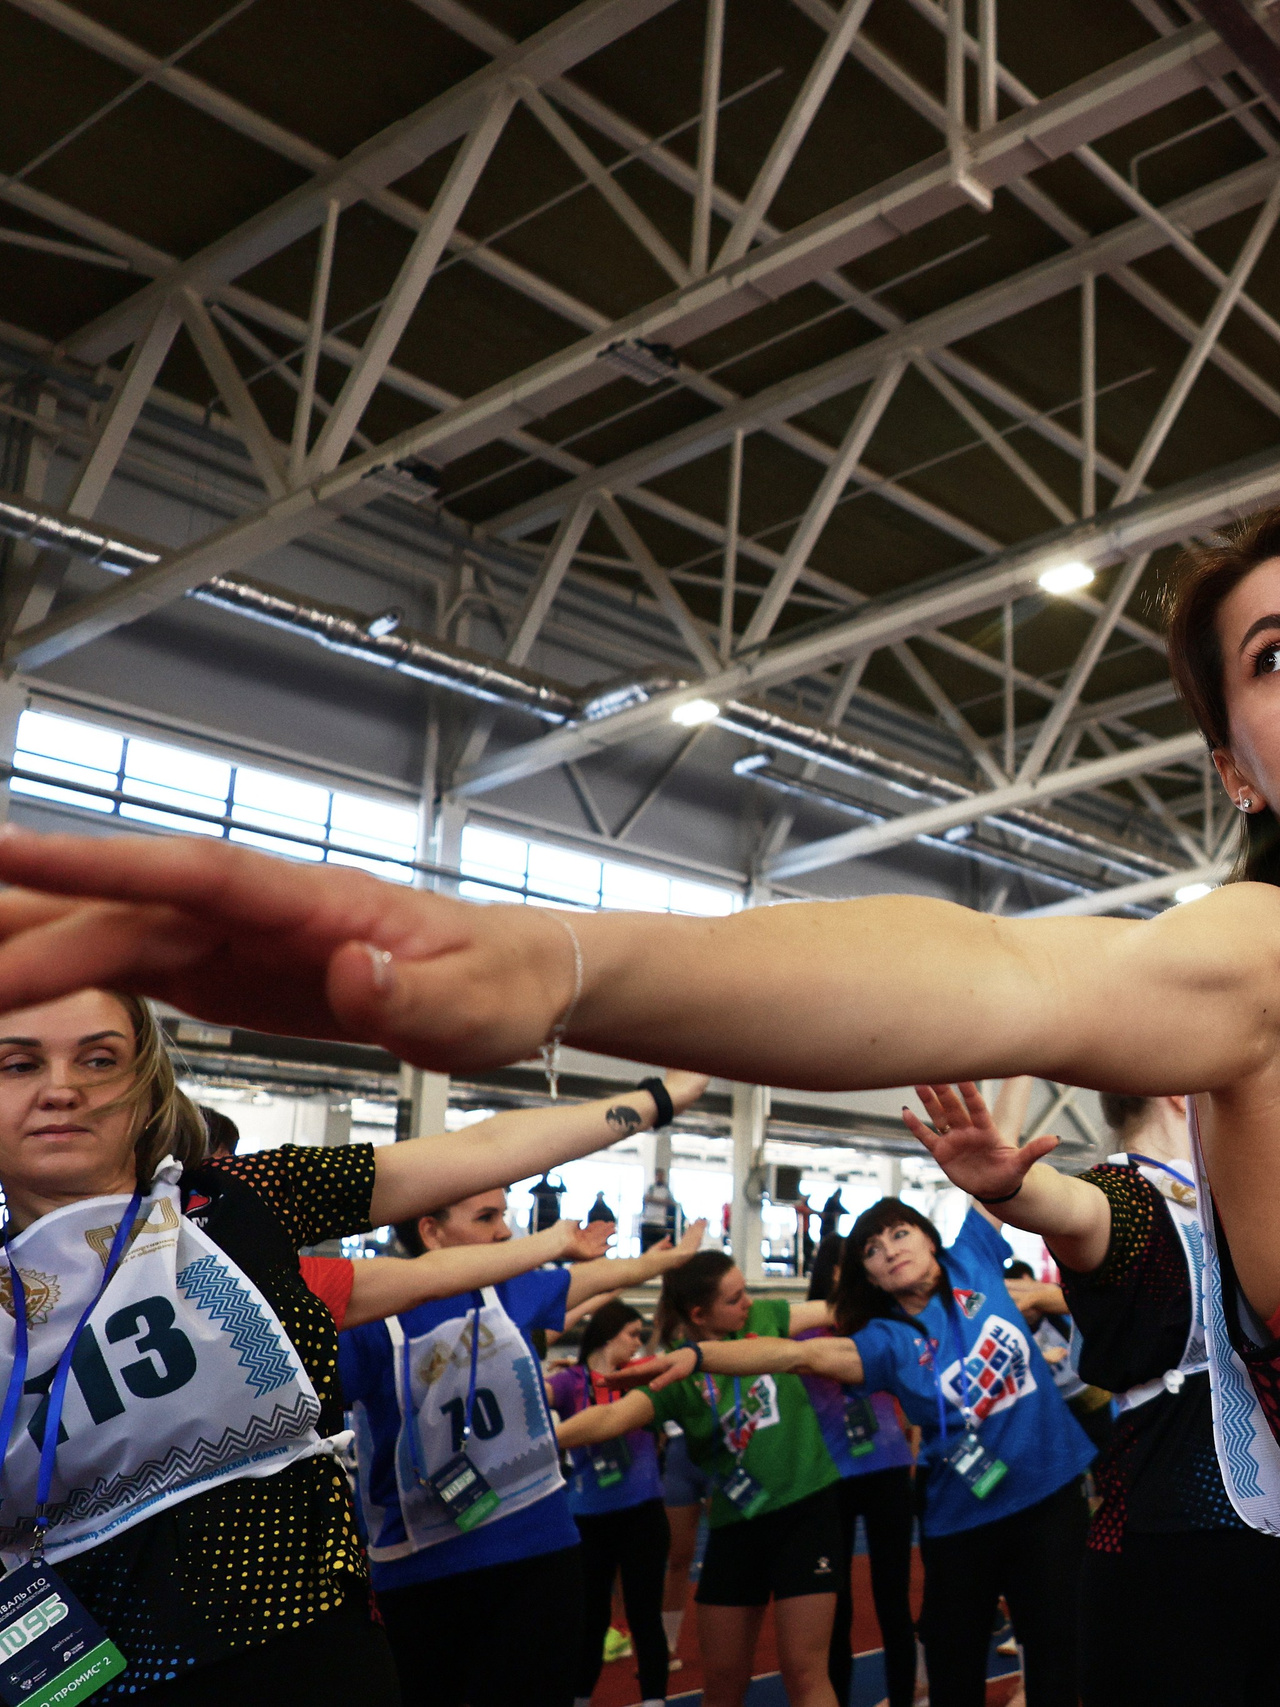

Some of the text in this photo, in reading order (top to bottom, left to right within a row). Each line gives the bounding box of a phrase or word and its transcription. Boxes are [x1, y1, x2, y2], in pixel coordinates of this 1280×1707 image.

[251, 1445, 289, 1463] области
[26, 1577, 46, 1595] ГТО
[49, 1661, 102, 1702] "ПРОМИС"
[102, 1656, 112, 1666] 2
